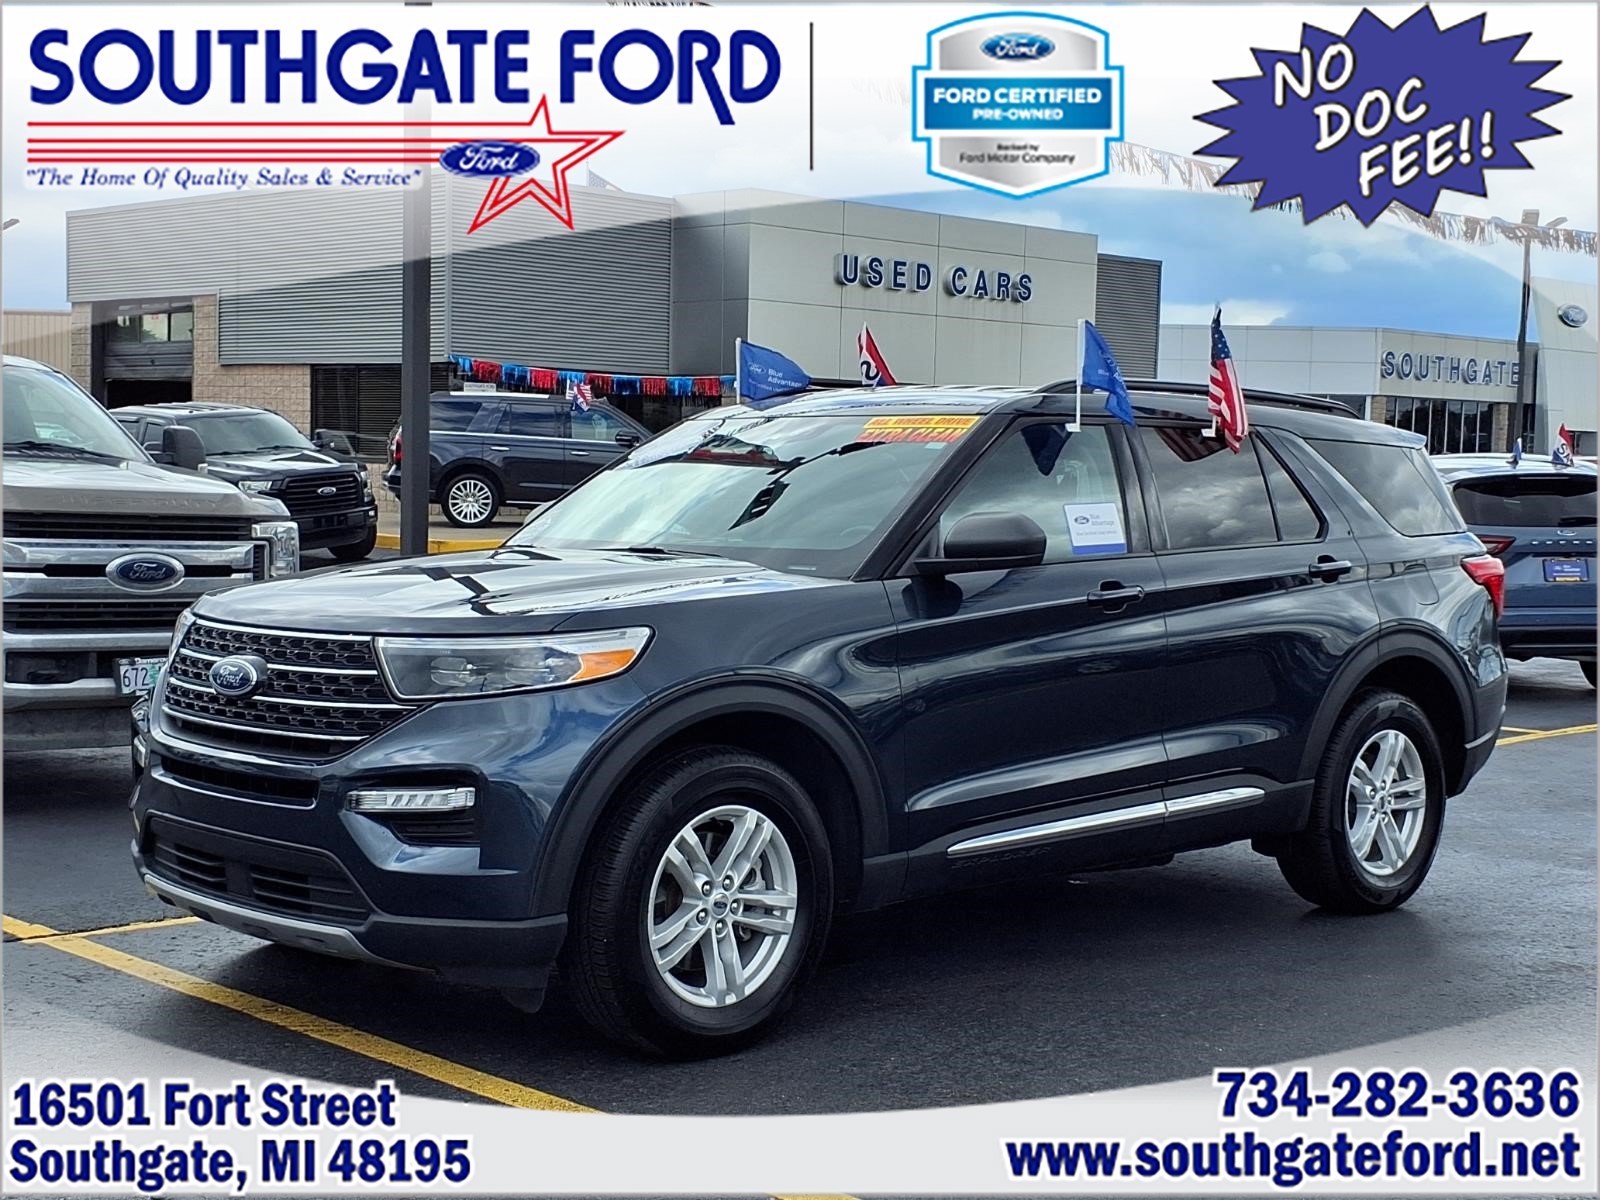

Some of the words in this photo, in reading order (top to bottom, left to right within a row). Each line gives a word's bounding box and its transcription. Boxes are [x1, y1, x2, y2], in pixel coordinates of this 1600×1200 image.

[836, 253, 932, 292] USED
[946, 266, 1033, 302] CARS
[1382, 350, 1521, 387] SOUTHGATE
[935, 417, 975, 426] DRIVE
[856, 428, 913, 443] EXTRA
[907, 428, 969, 443] CLEAN
[129, 562, 167, 580] Ford
[122, 667, 150, 688] 672
[216, 665, 244, 687] Ford
